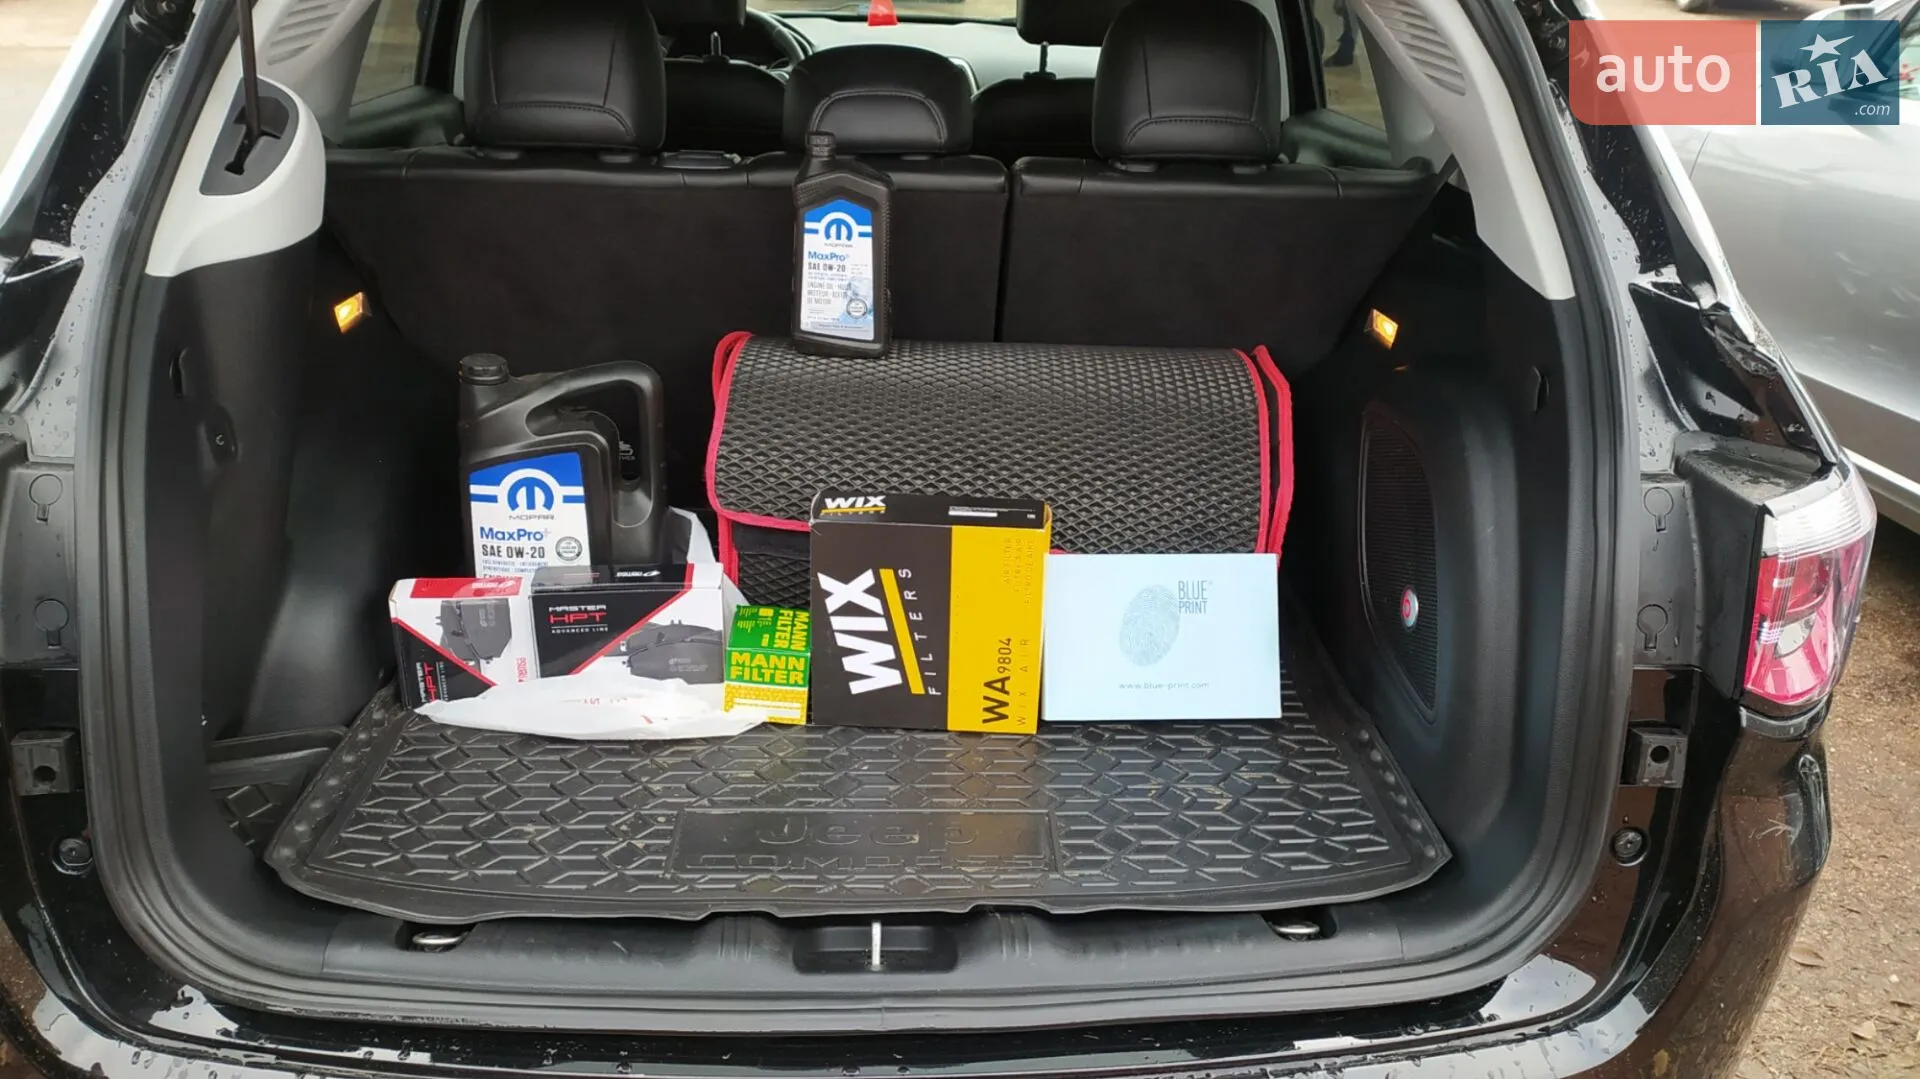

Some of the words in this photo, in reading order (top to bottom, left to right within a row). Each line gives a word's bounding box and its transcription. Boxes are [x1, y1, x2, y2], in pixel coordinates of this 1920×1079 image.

[808, 261, 821, 271] SAE
[824, 495, 887, 509] WIX
[481, 544, 503, 557] SAE
[506, 545, 546, 559] 0W-20
[548, 604, 608, 612] MASTER
[549, 611, 608, 624] HPT
[1178, 601, 1207, 614] PRINT
[774, 608, 792, 649] FILTER
[790, 610, 810, 651] MANN
[817, 568, 903, 695] WIX
[898, 568, 942, 696] FILTERS
[731, 650, 806, 671] MANN
[1019, 638, 1029, 673] AIR
[423, 662, 437, 702] HPT
[729, 665, 804, 685] FILTER
[981, 637, 1012, 724] WA9804
[1119, 681, 1210, 690] www.blue-print.com
